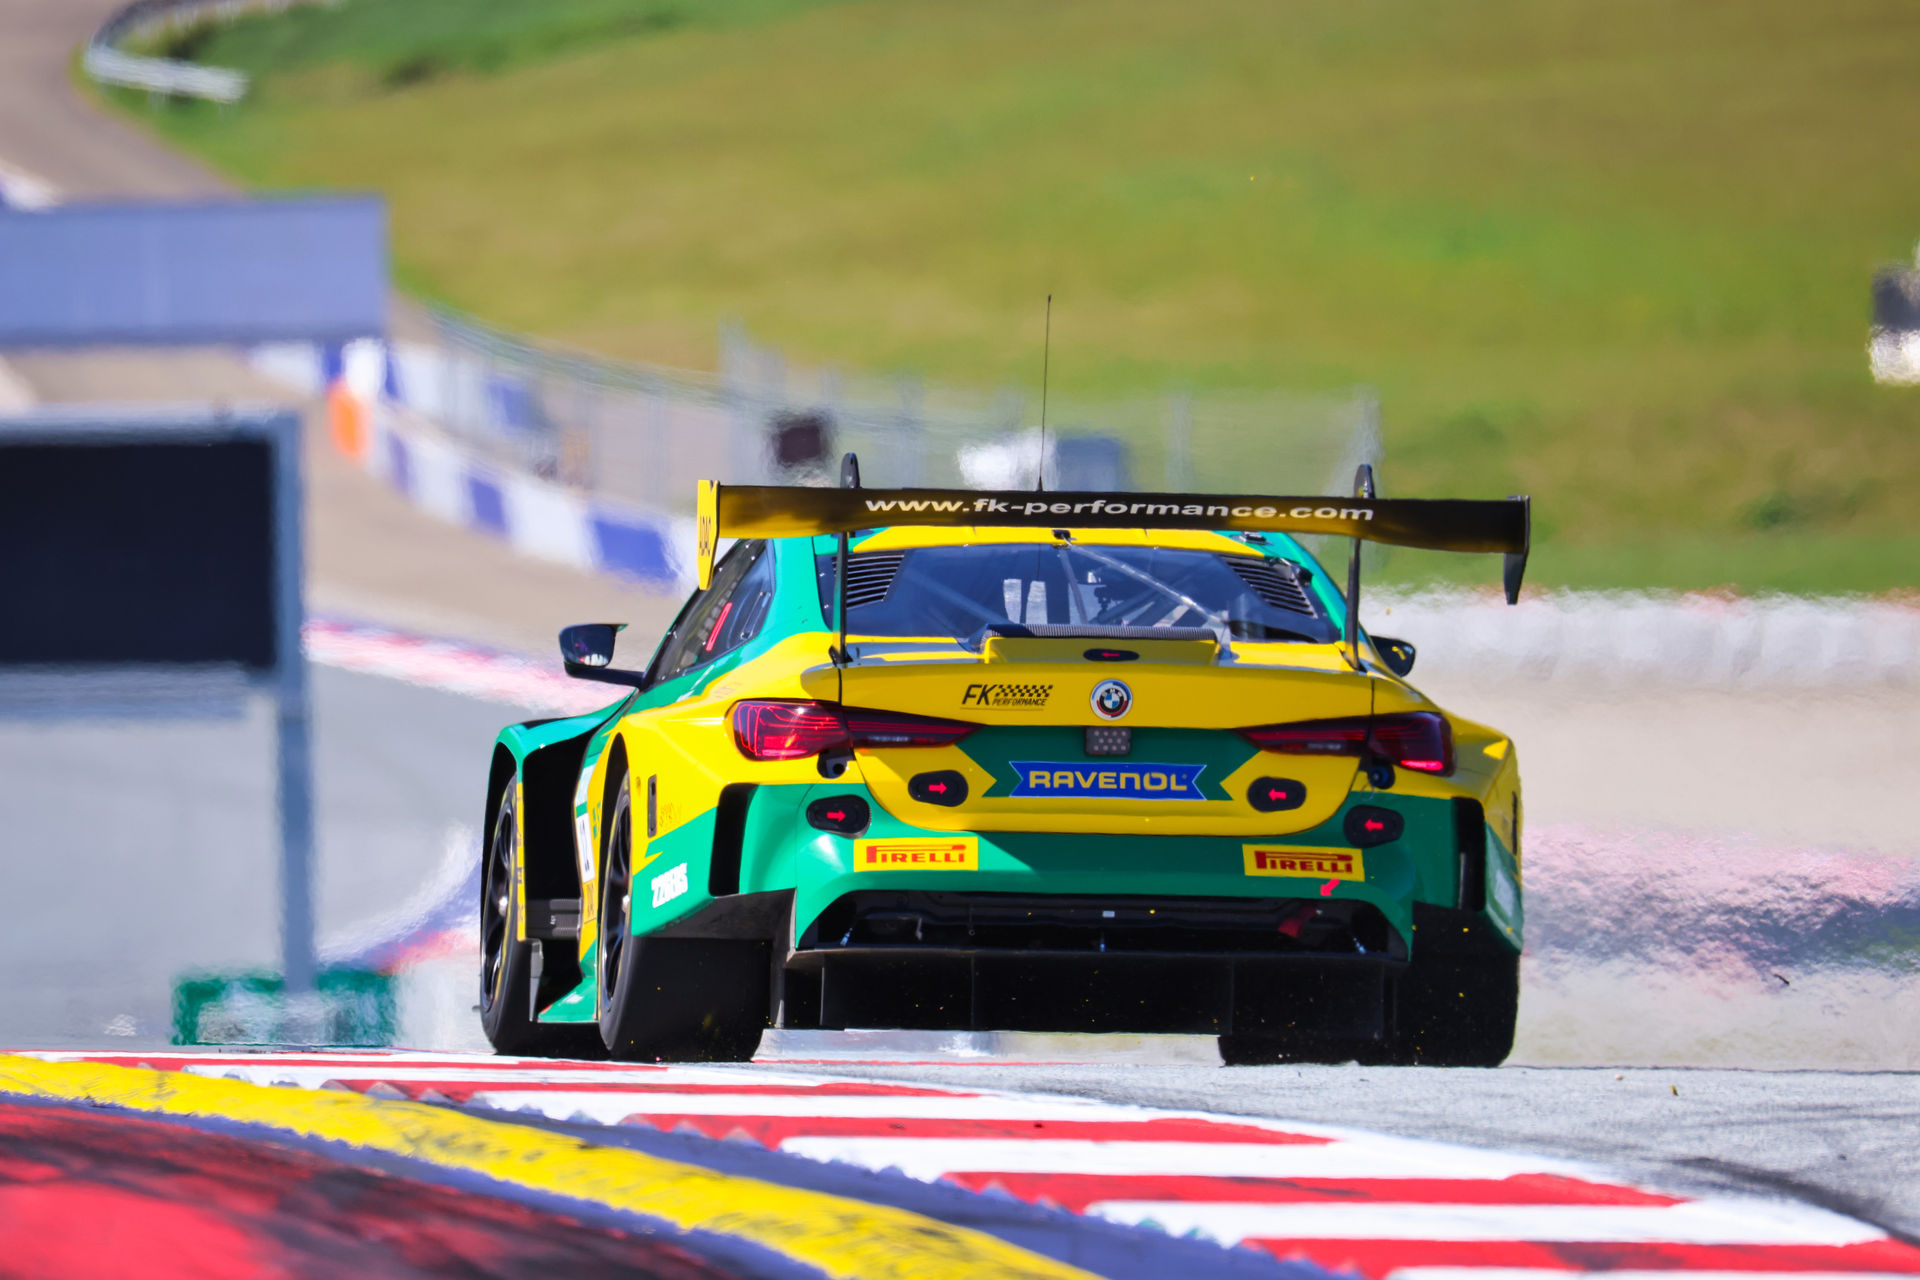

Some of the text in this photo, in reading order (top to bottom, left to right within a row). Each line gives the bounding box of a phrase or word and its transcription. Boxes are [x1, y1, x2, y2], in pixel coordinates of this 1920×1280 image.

[865, 498, 1374, 521] www.fk-performance.com
[962, 684, 997, 706] FK
[992, 698, 1048, 707] PERFORMANCE
[1029, 770, 1188, 791] RAVENOL
[866, 844, 967, 863] PIRELLI
[1254, 850, 1354, 874] PIRELLI
